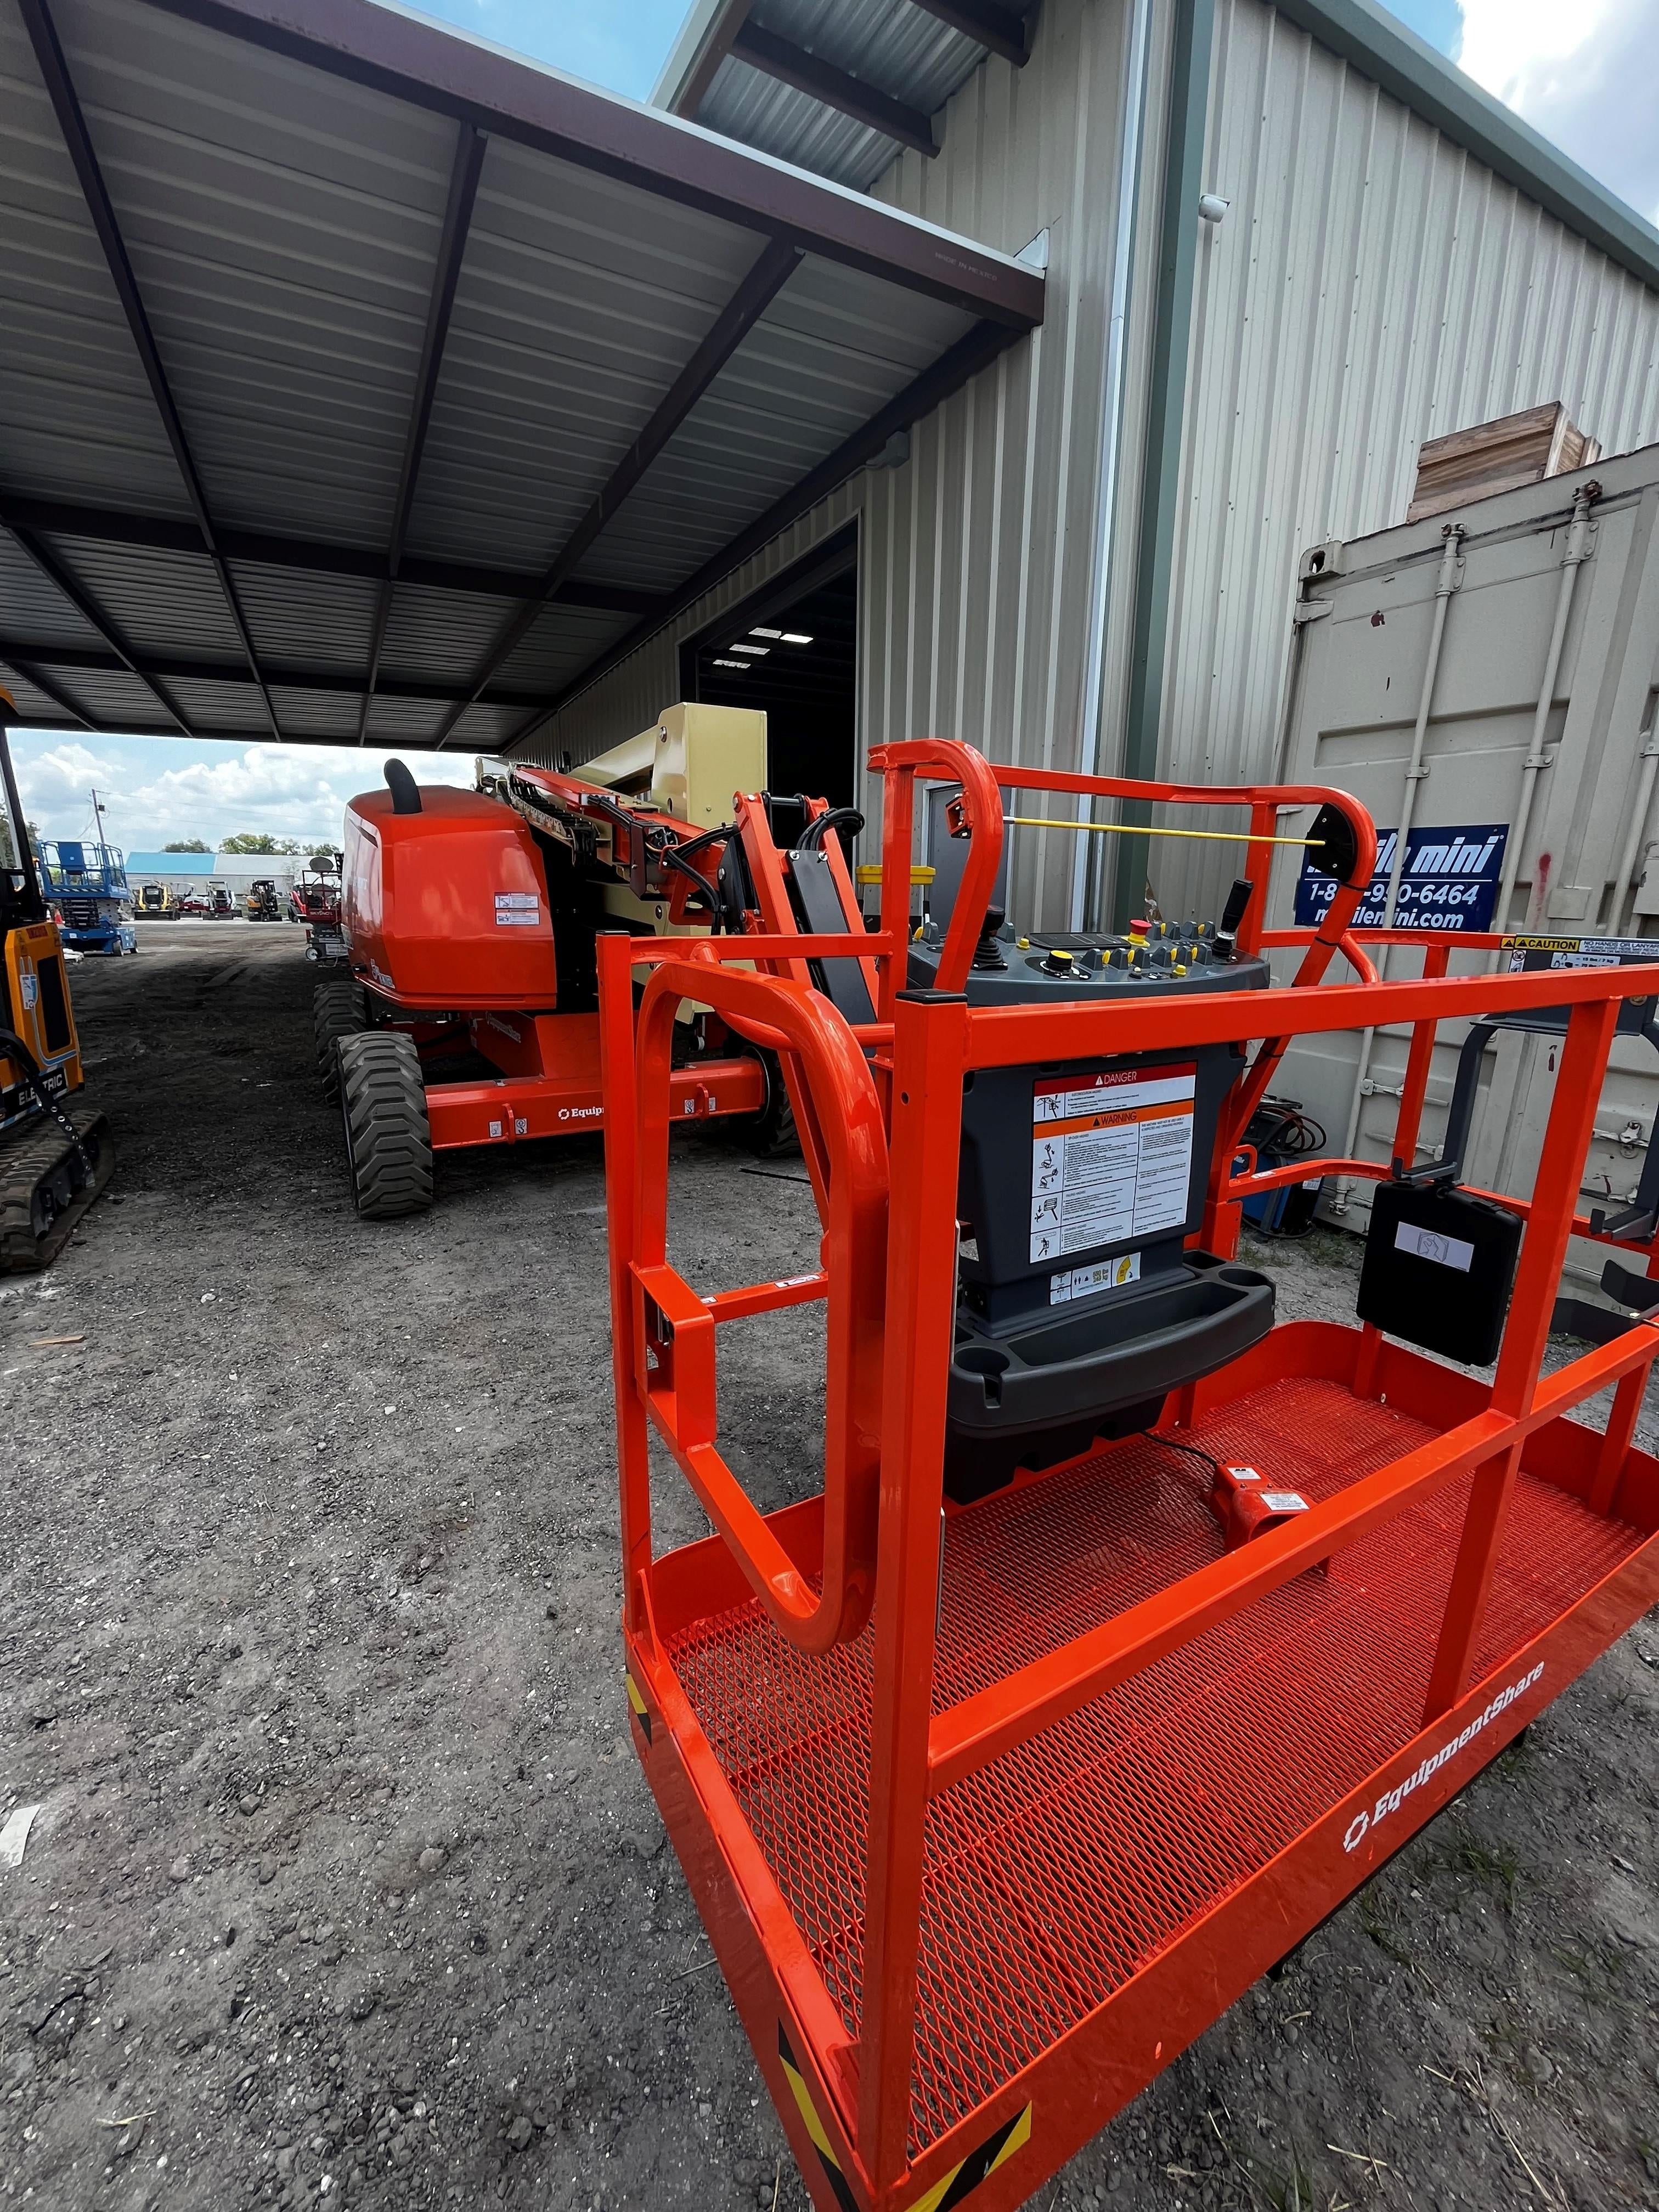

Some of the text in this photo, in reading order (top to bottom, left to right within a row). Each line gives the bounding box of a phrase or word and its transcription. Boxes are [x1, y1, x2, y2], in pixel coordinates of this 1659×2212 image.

[1409, 836, 1500, 873] mini
[1310, 883, 1480, 905] 1-8-90-6464
[1314, 906, 1464, 928] milemini.com
[1528, 939, 1577, 950] CAUTION
[1104, 1071, 1137, 1085] DANGER
[19, 1074, 63, 1105] ELETRIC
[1101, 1111, 1137, 1125] WARNING
[1372, 1661, 1544, 1826] EquipmentShare
